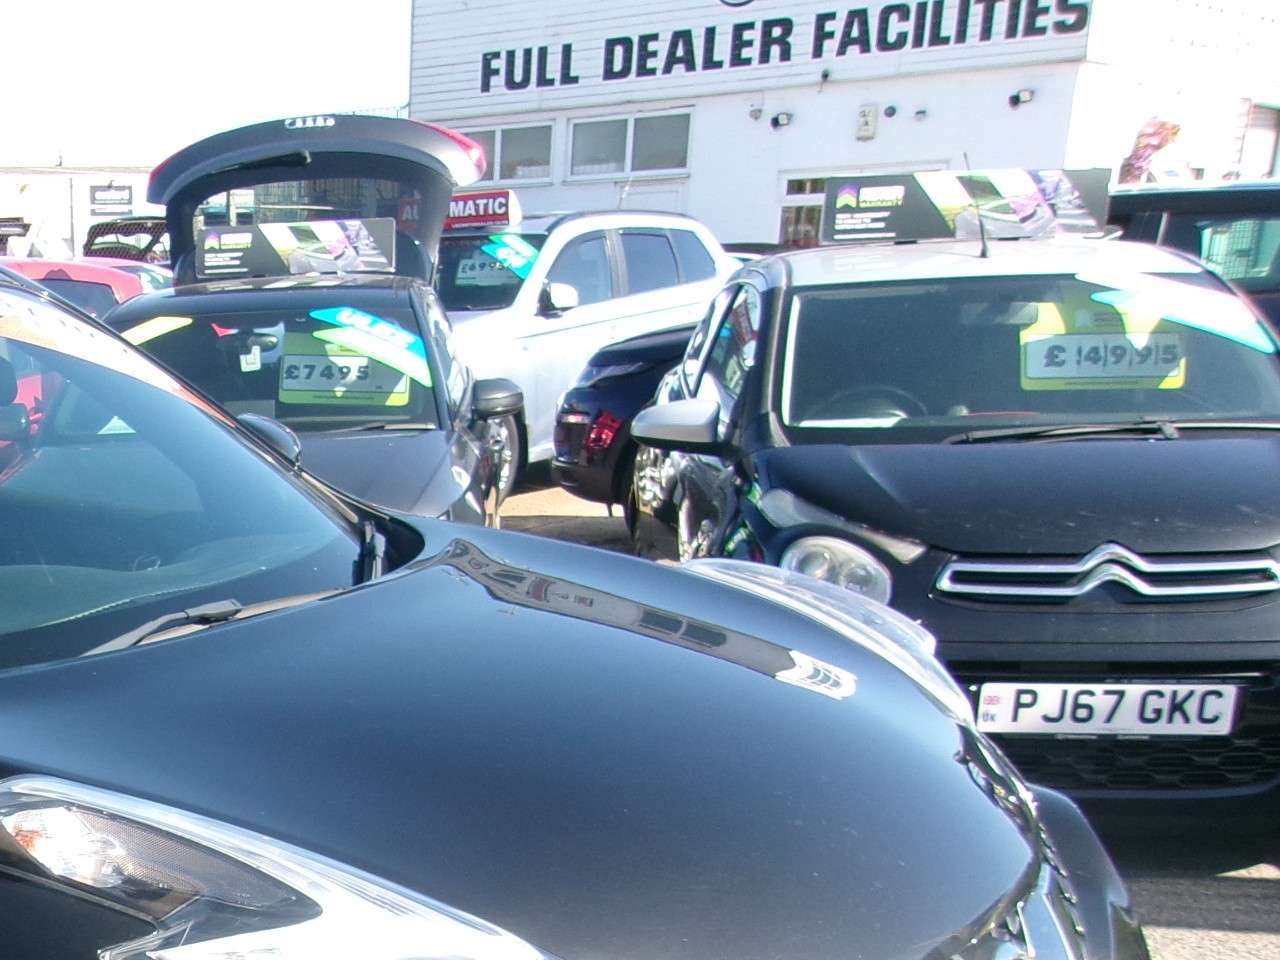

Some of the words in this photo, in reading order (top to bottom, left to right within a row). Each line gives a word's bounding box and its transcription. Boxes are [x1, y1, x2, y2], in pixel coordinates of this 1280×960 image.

[480, 43, 579, 93] FULL
[602, 17, 792, 82] DEALER
[811, 0, 1089, 60] FACILITIES
[284, 364, 370, 381] £7495
[1011, 688, 1125, 724] PJ67
[1138, 689, 1224, 725] GKC
